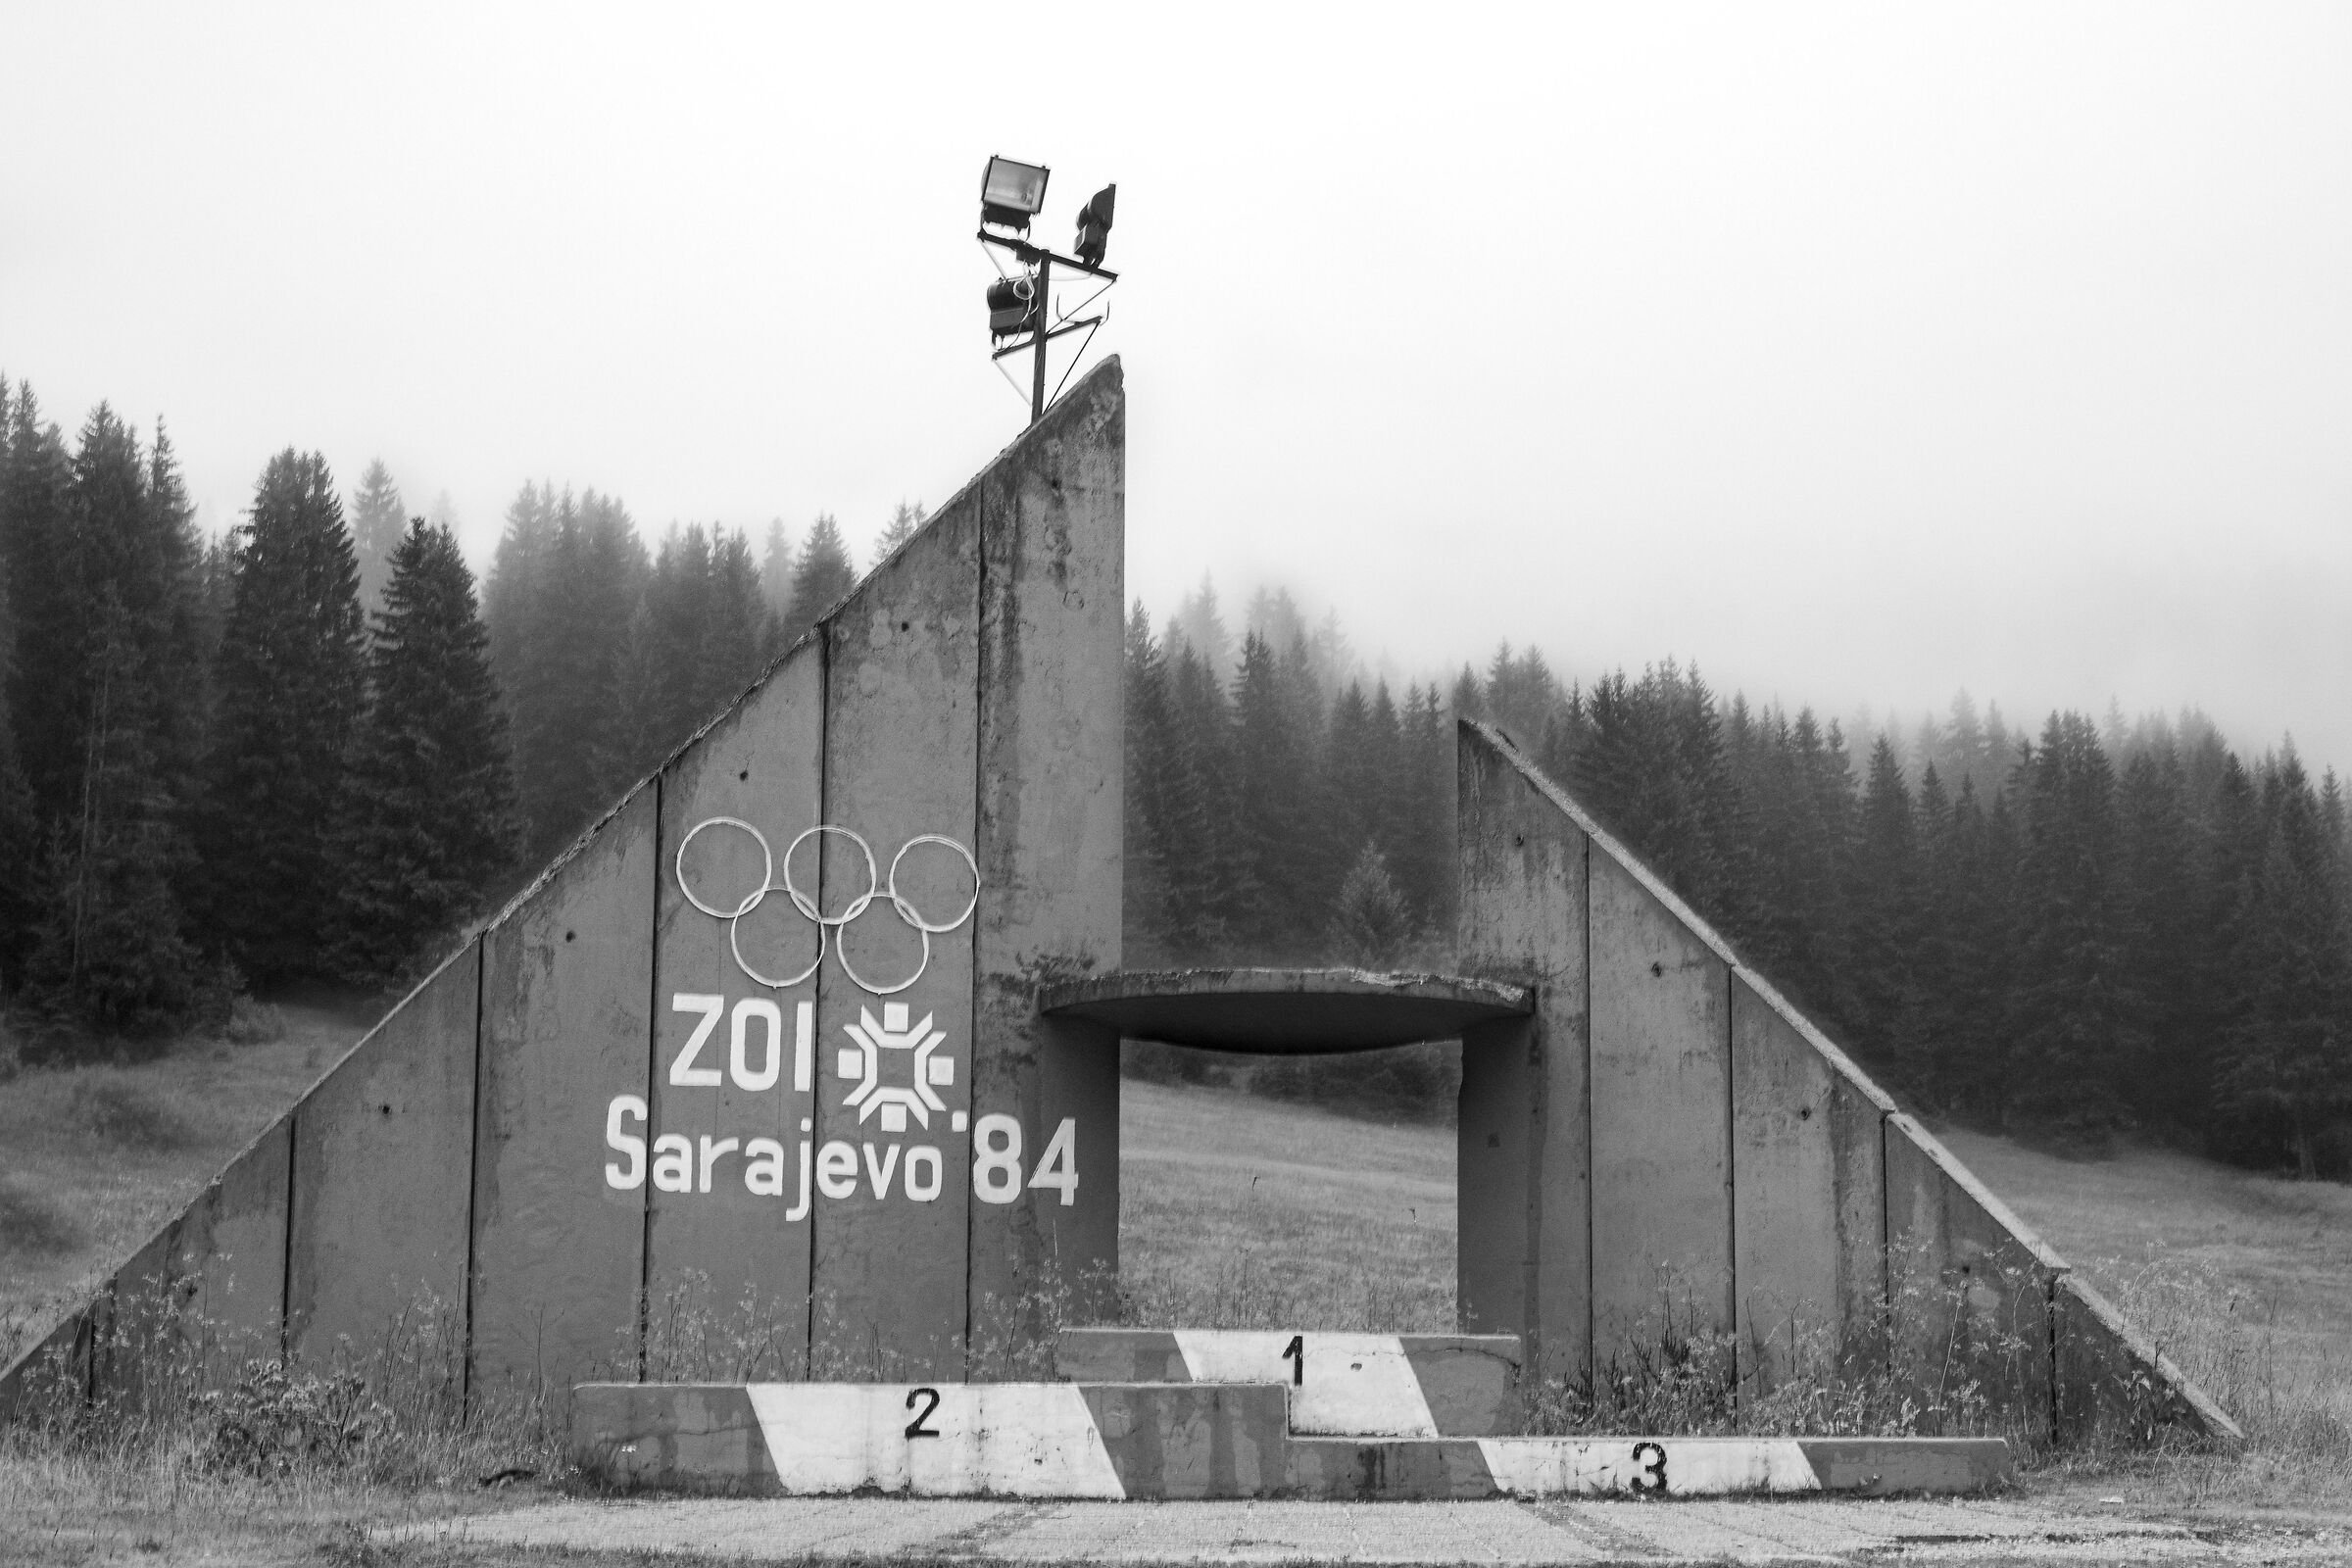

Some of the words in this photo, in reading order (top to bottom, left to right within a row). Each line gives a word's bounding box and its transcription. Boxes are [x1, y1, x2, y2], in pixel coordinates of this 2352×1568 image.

[669, 992, 813, 1093] ZOI
[605, 1094, 943, 1222] Sarajevo
[952, 1109, 1079, 1206] '84
[1282, 1335, 1303, 1387] 1
[905, 1387, 941, 1440] 2
[1631, 1442, 1668, 1494] 3
